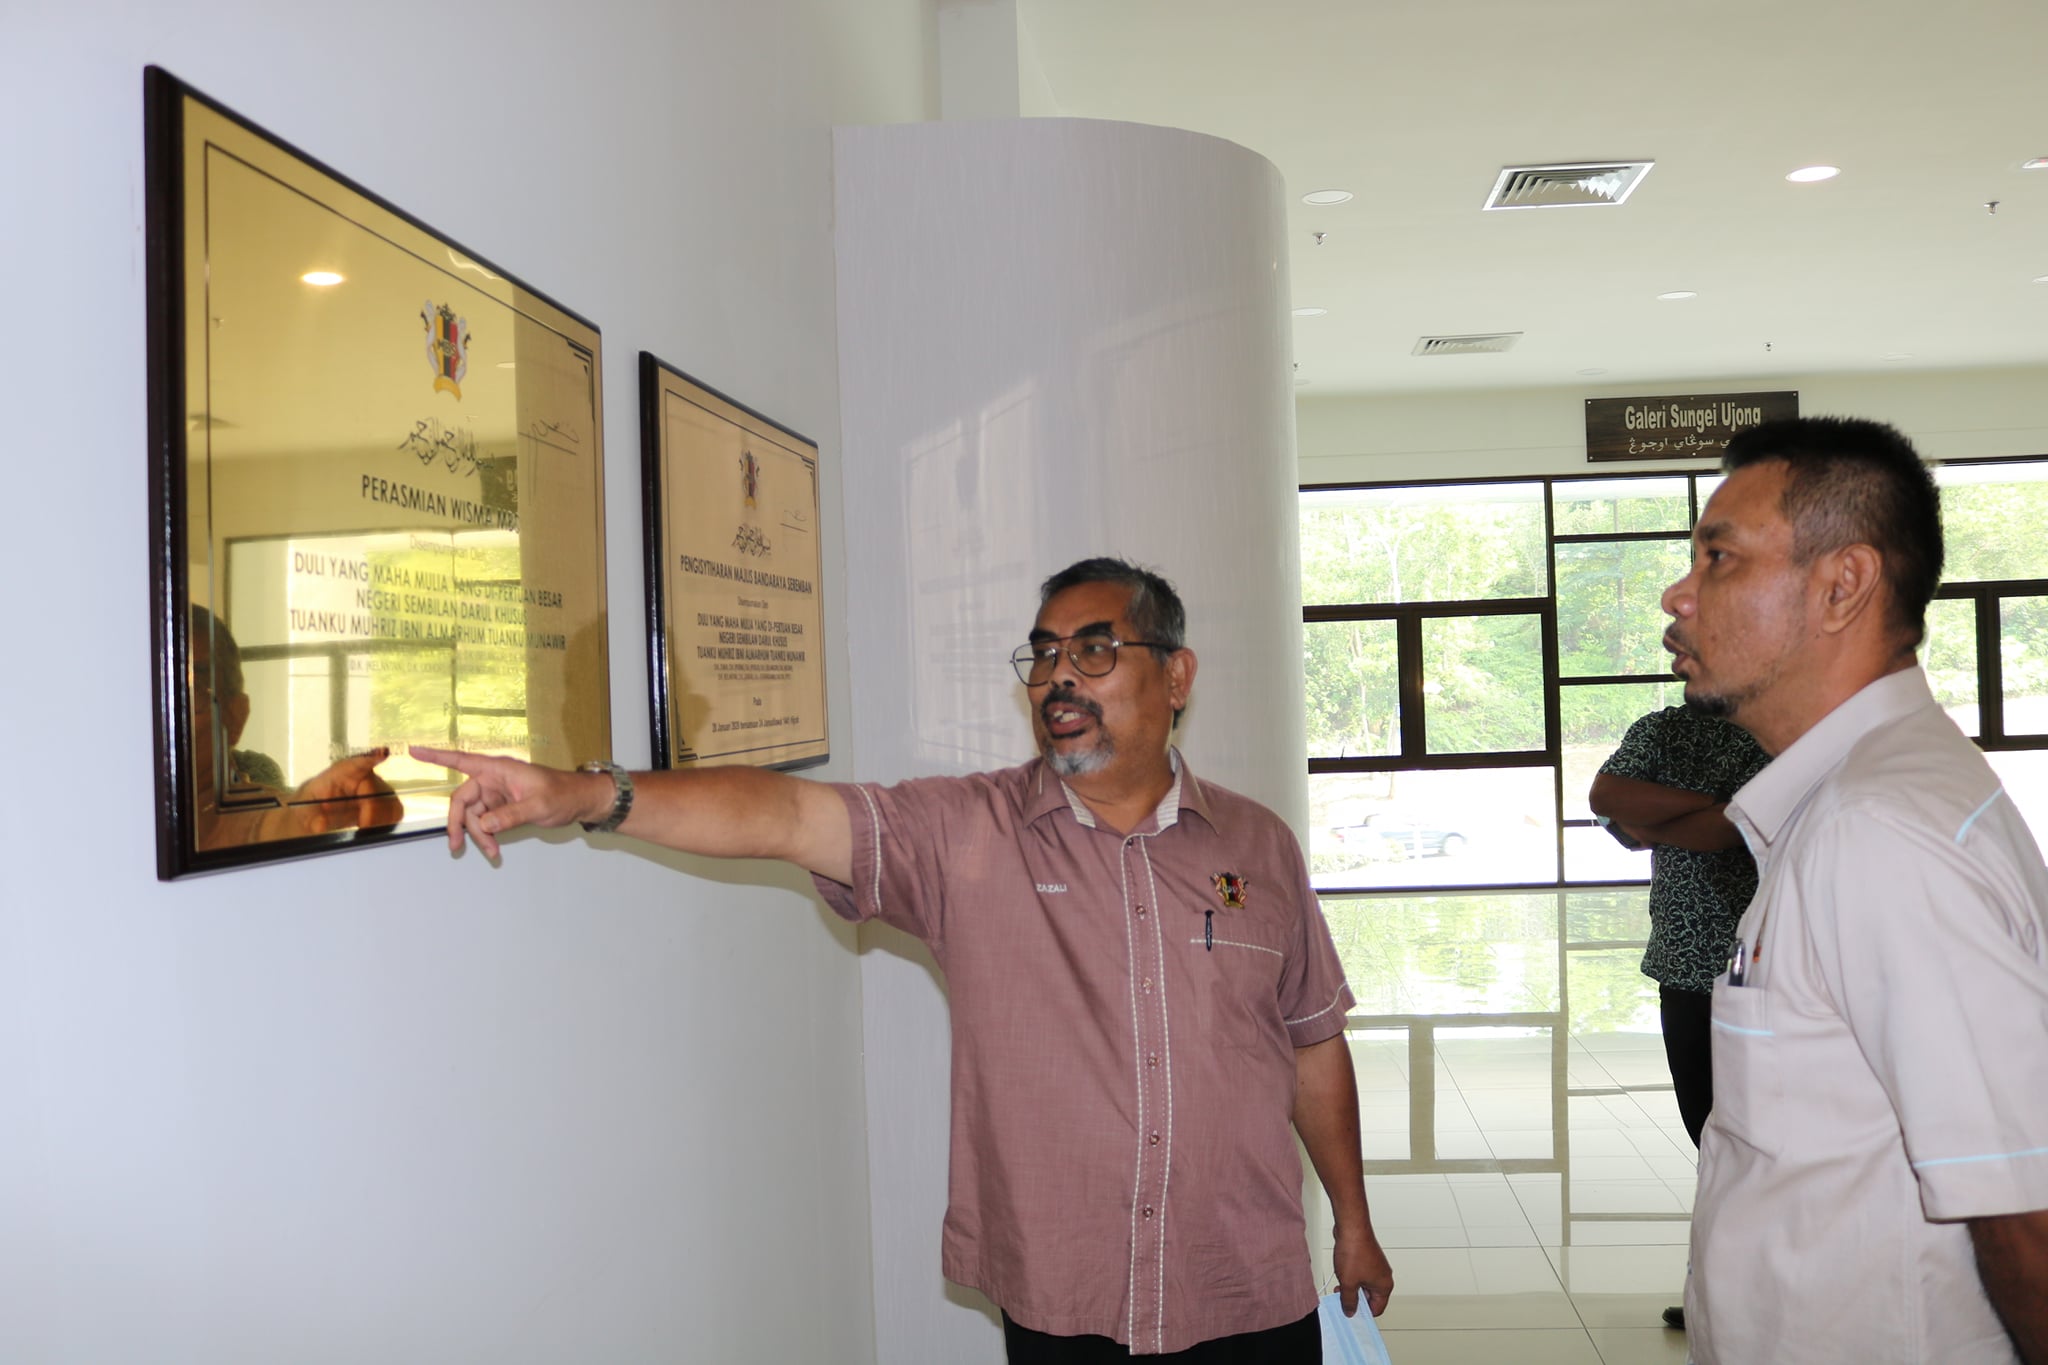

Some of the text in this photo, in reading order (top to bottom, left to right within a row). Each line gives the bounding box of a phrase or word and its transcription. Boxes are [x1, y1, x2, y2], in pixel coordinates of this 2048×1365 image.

[1625, 401, 1760, 433] Galeri Sungei Ujong
[362, 474, 447, 516] PERASMIAN
[450, 498, 492, 525] WISMA
[295, 551, 325, 576] DULI
[329, 557, 368, 582] YANG
[373, 564, 411, 588] MAHA
[414, 570, 448, 592] MULIA
[453, 576, 482, 598] YANG
[538, 589, 563, 608] BESAR
[356, 588, 528, 626] NEGERI SEMBILAN DARUL KHUSUS
[290, 608, 346, 634] TUANKU
[350, 615, 396, 638] MUHRIZ
[400, 619, 423, 640] IBNI
[426, 622, 486, 644] ALMARHUM
[488, 628, 524, 648] TUANKU
